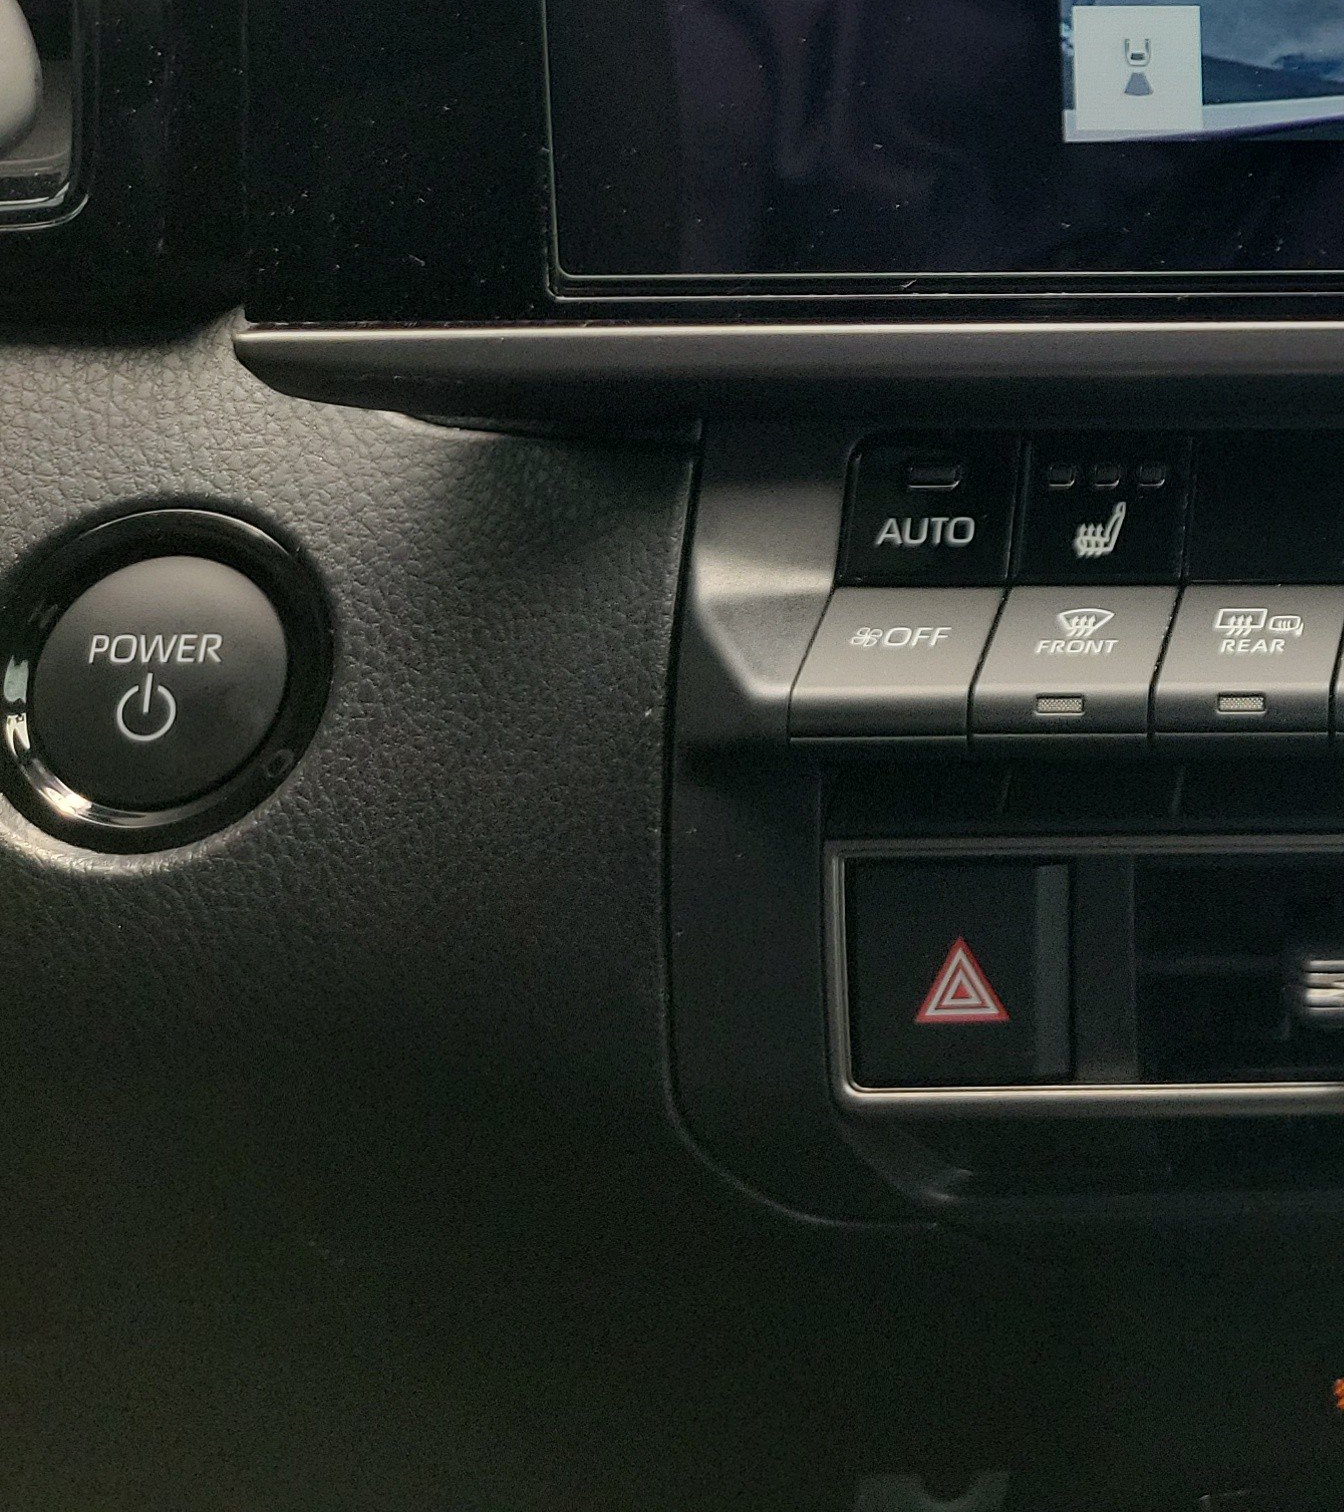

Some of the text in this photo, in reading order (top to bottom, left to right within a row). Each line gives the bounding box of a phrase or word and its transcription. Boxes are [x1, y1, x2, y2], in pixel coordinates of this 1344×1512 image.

[875, 517, 975, 547] AUTO
[883, 626, 952, 647] OFF
[1035, 639, 1118, 655] FRONT
[1220, 638, 1286, 654] REAR
[88, 633, 224, 664] POWER
